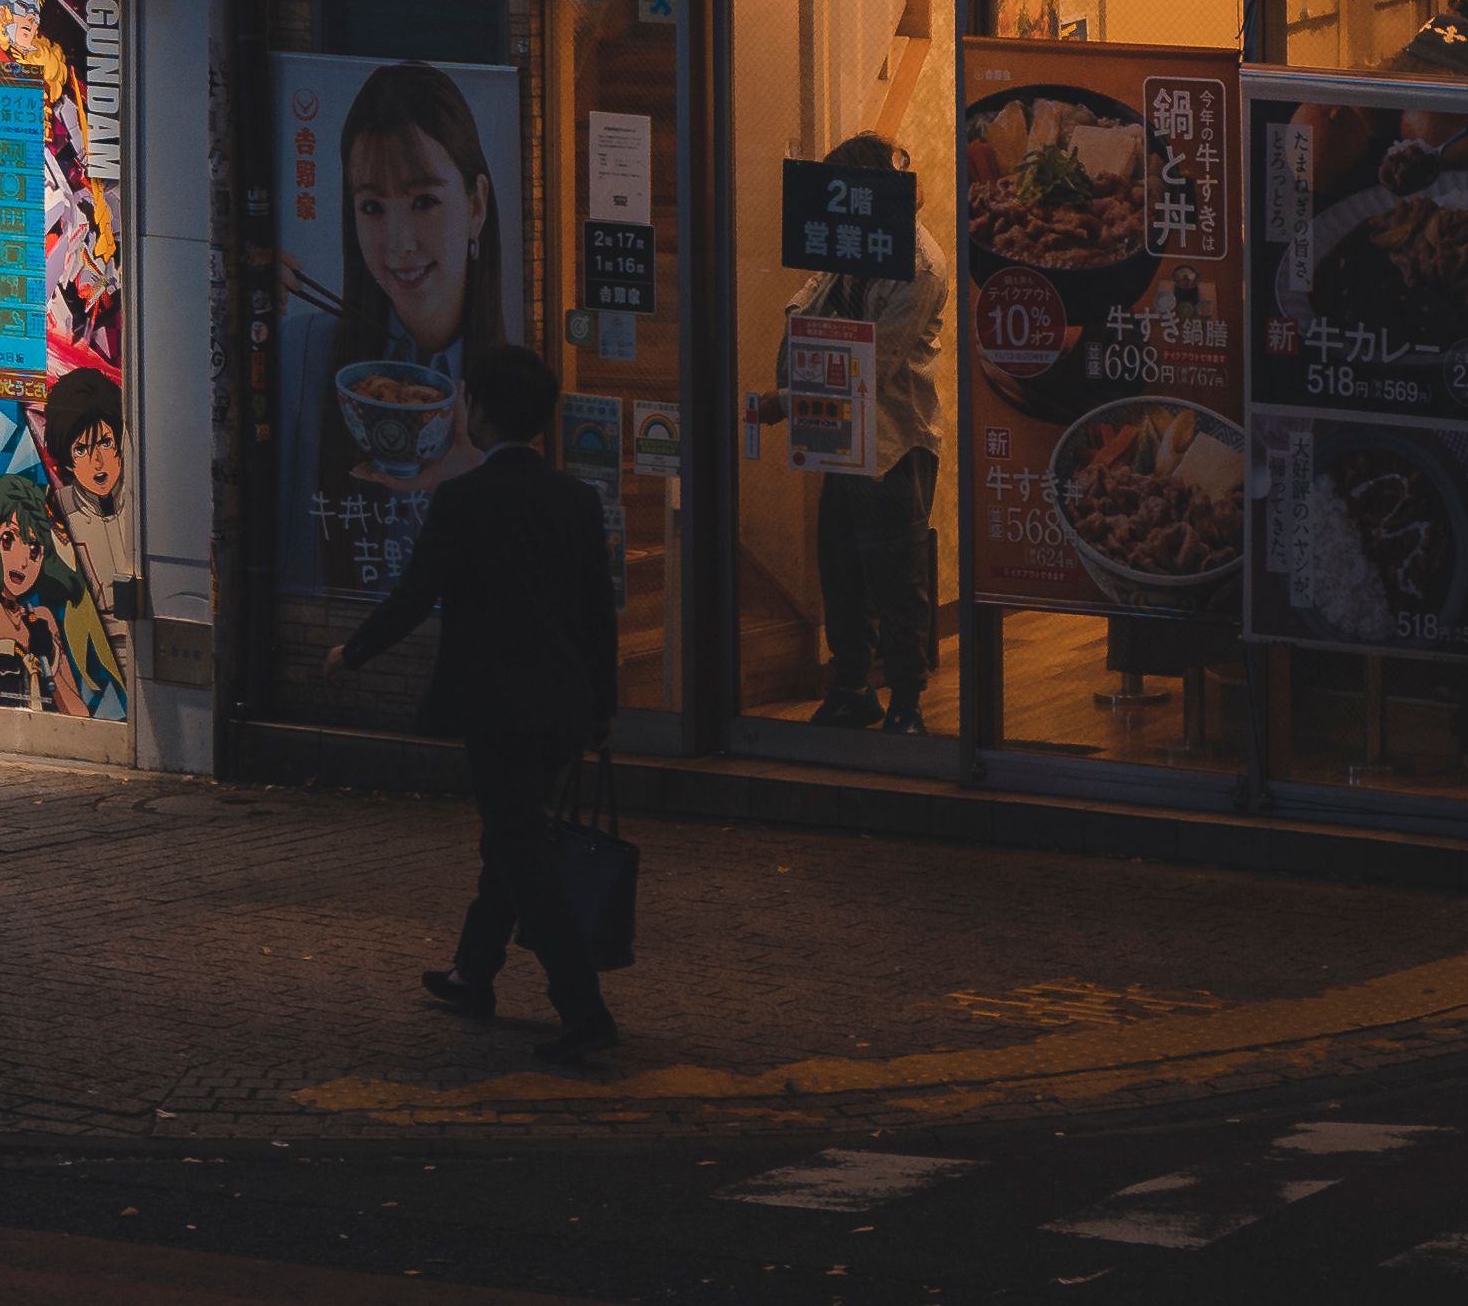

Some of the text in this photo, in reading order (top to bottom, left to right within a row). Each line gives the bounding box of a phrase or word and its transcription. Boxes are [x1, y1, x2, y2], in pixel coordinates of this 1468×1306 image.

[1153, 87, 1197, 249] 鍋と丼
[1196, 89, 1220, 252] 今年の牛すきは
[826, 178, 873, 219] 2階
[803, 220, 894, 264] 営業中
[988, 287, 1053, 302] テイクアウト
[1105, 304, 1229, 348] 牛すき鍋膳
[1268, 316, 1441, 365] 新 牛カレー
[1103, 343, 1176, 385] 698円
[1306, 363, 1368, 398] 518円
[987, 430, 1008, 456] 新
[985, 465, 1085, 507] 牛すき丼
